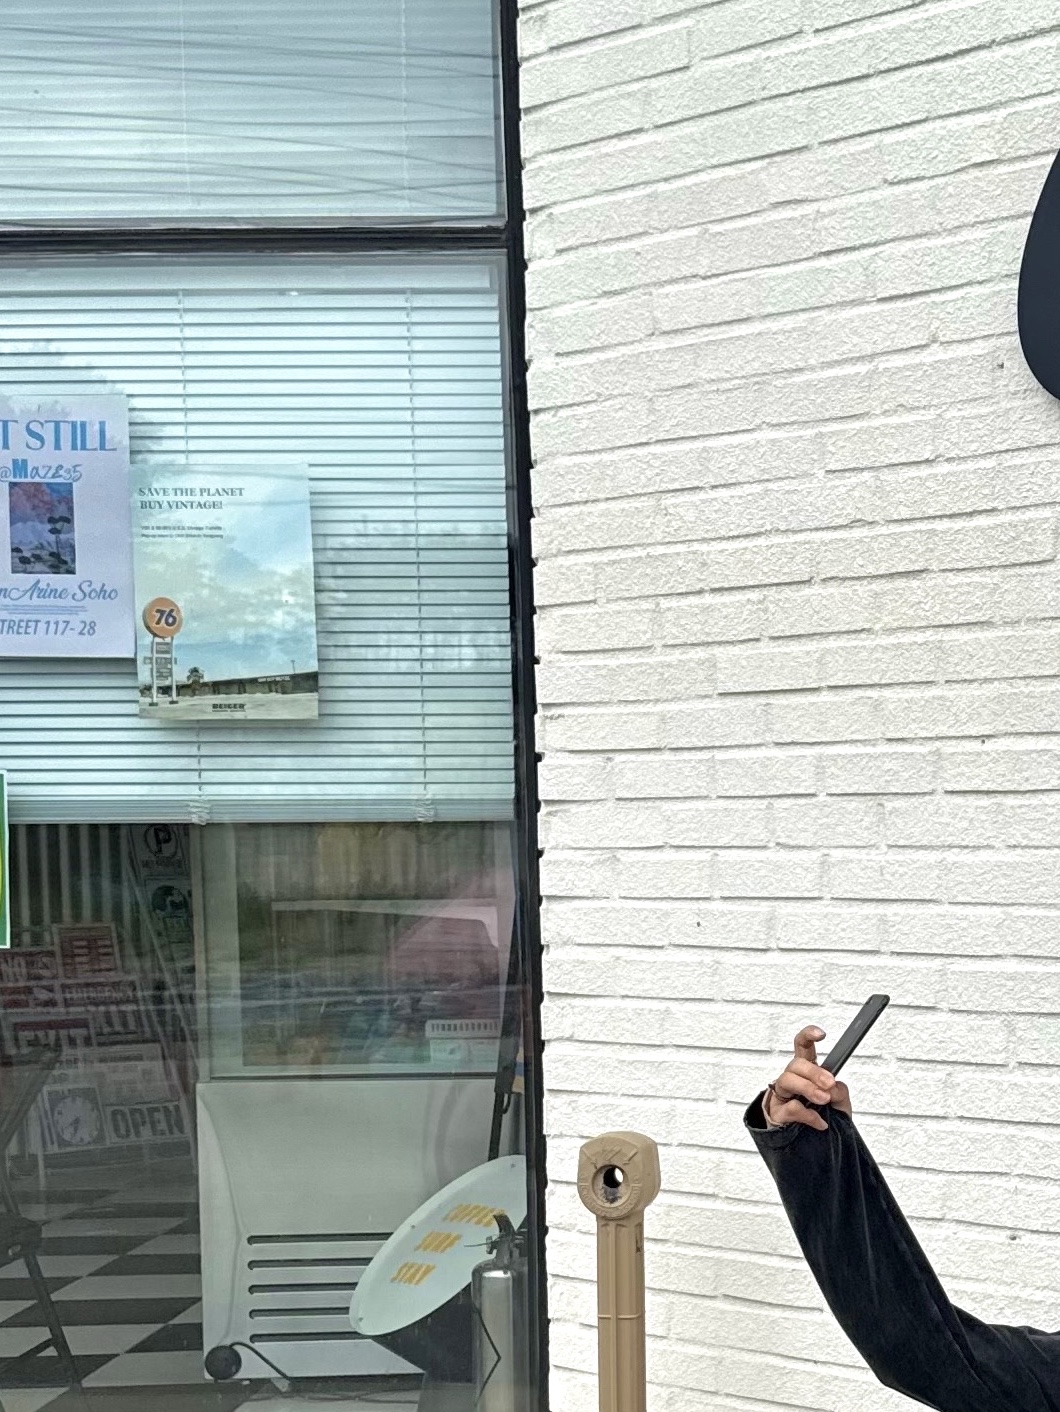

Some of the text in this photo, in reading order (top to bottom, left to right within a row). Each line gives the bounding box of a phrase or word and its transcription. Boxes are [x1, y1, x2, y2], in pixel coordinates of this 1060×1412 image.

[25, 419, 117, 452] STILL
[138, 487, 245, 497] SAVE THE PLANET
[140, 500, 224, 510] BUY VINTAGE!
[72, 579, 119, 602] Soho
[155, 608, 177, 627] 76
[111, 1104, 185, 1139] OPEN
